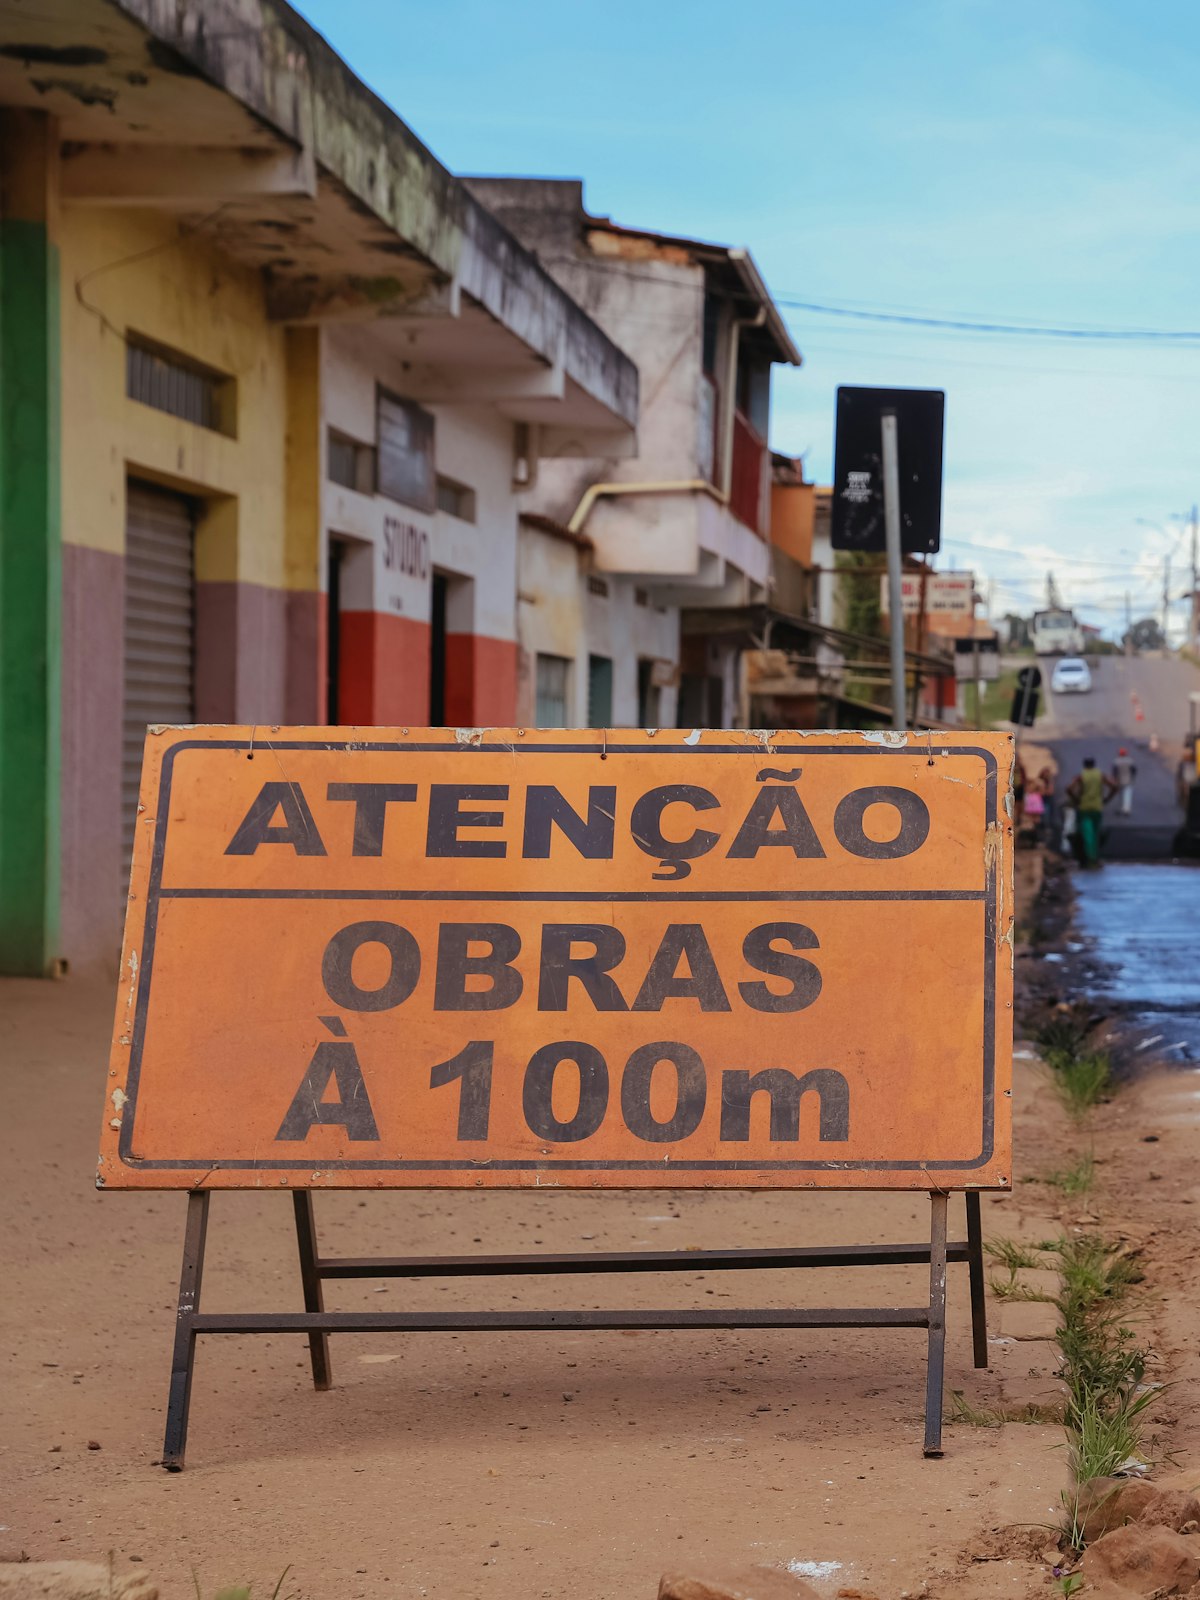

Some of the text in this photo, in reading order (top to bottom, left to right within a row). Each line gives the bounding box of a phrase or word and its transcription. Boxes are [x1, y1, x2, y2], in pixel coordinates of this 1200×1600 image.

[383, 514, 432, 581] STUDIO
[223, 767, 931, 881] ATENÇÃO
[321, 920, 823, 1014] OBRAS
[274, 1015, 850, 1143] À 100m
